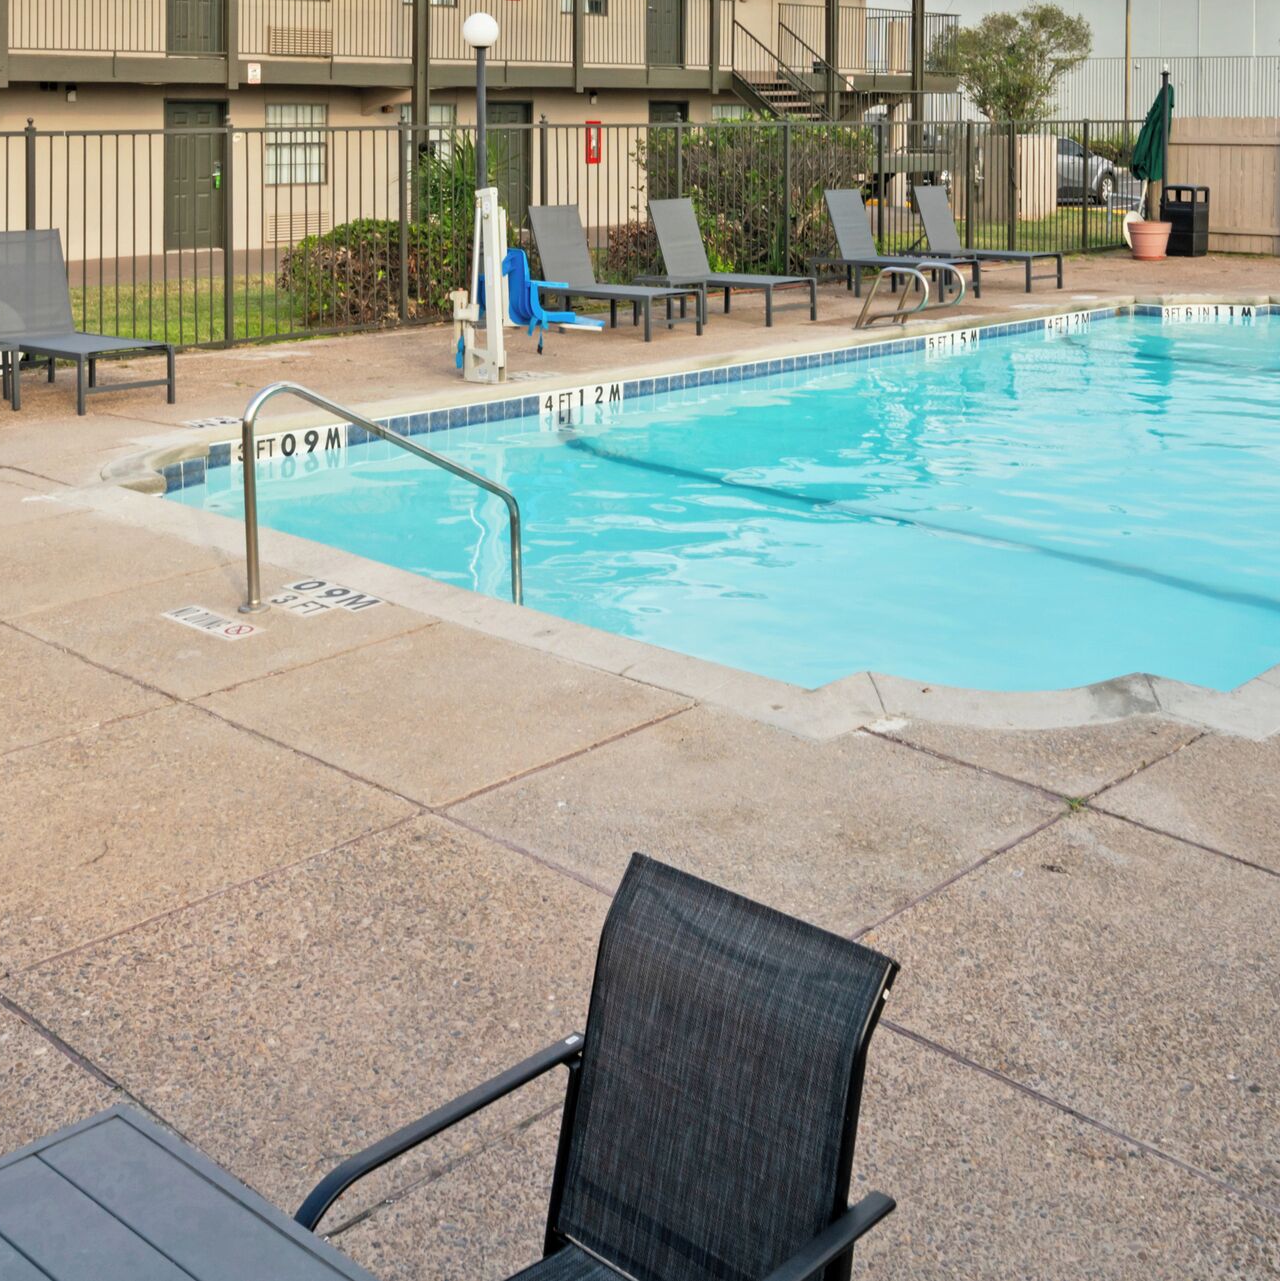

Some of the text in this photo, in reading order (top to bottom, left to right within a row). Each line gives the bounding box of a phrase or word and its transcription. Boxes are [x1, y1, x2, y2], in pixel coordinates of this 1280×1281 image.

[1081, 312, 1090, 324] M
[1185, 306, 1193, 317] 6
[1241, 306, 1252, 318] M
[969, 329, 978, 343] M
[544, 395, 554, 412] 4
[558, 391, 573, 411] FT
[608, 383, 621, 403] M
[256, 437, 276, 460] FT
[324, 426, 342, 451] M
